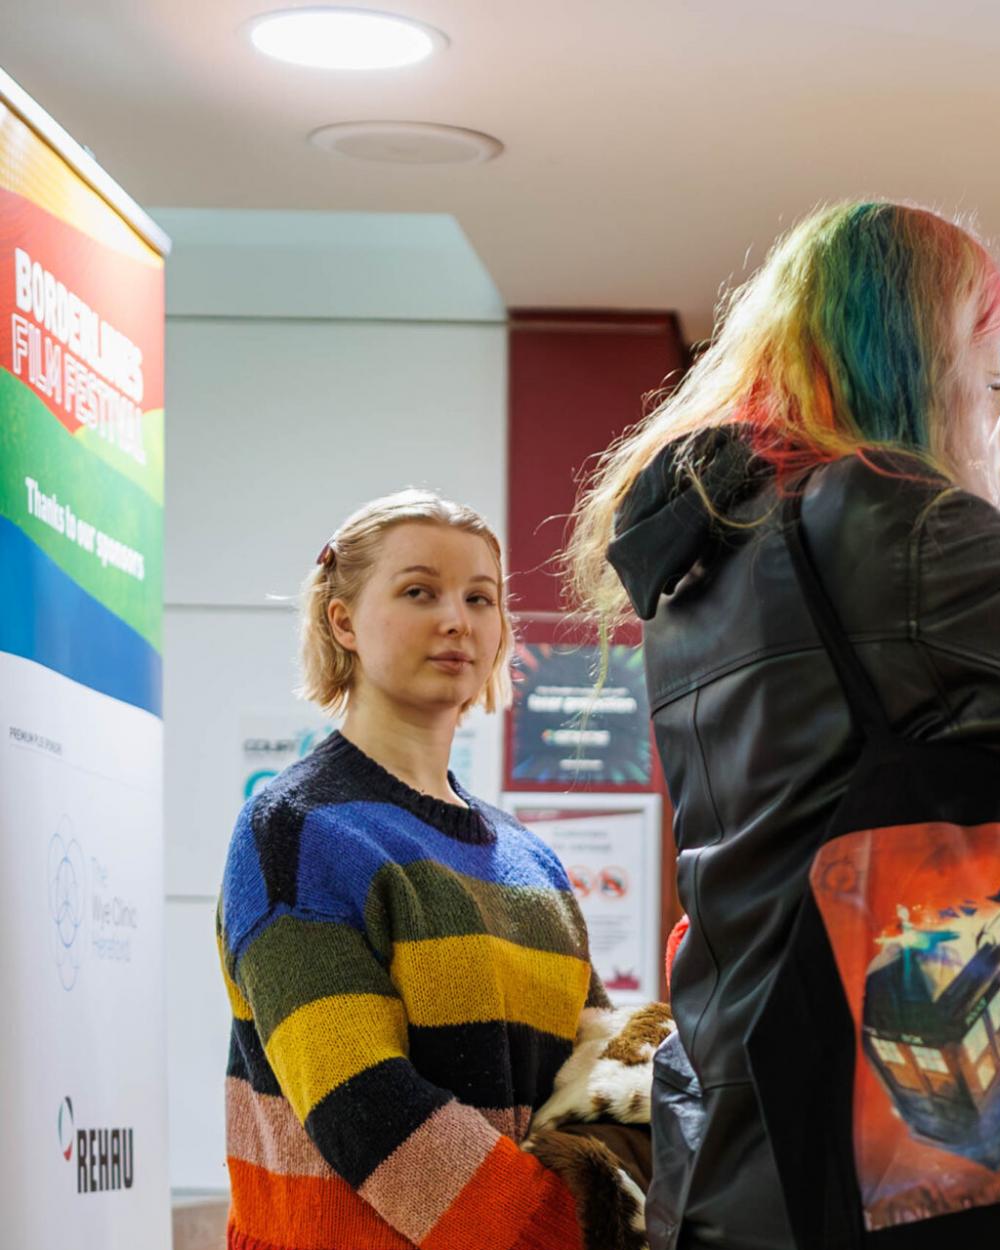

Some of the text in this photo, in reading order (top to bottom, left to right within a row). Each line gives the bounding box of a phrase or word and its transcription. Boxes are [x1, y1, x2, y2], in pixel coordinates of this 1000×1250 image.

[12, 313, 146, 466] FILM FESTIVAL
[25, 476, 145, 581] Thanks to our sponsors
[77, 1126, 134, 1194] REHAU
